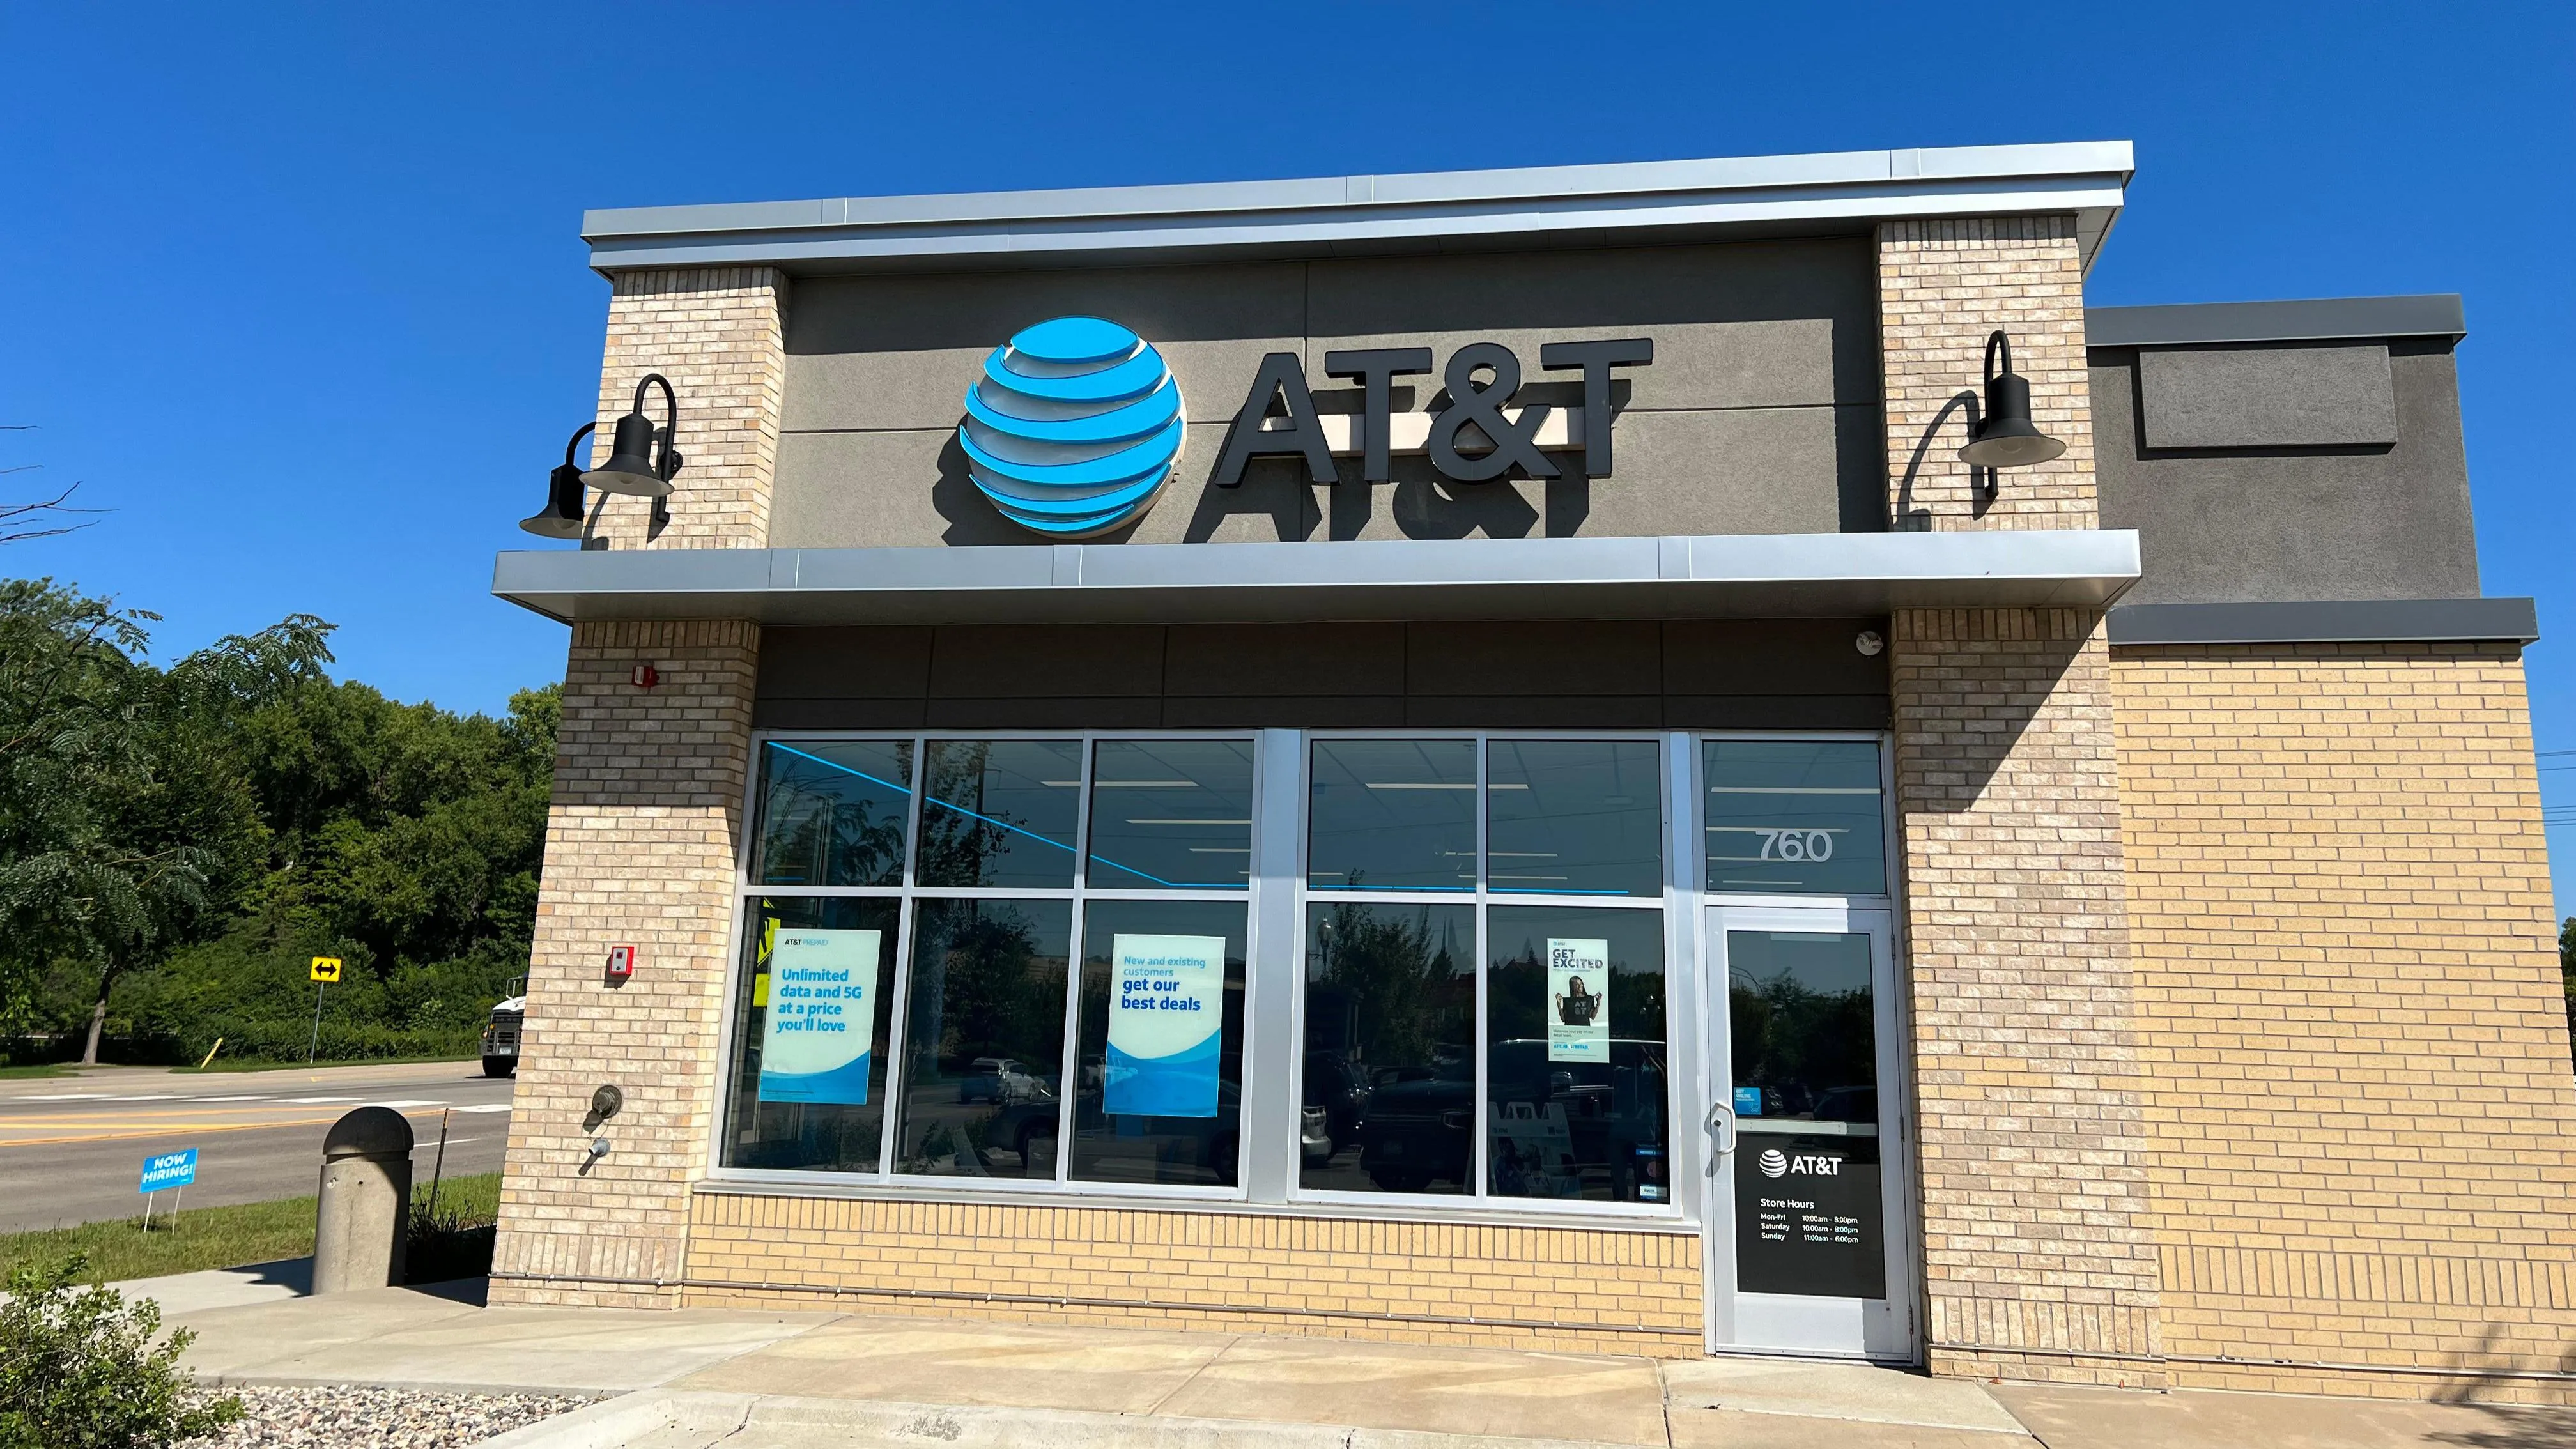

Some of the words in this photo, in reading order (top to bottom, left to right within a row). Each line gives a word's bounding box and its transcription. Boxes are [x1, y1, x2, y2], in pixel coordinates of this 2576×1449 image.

[1214, 338, 1653, 489] AT&T
[1755, 831, 1832, 862] 760
[1553, 949, 1575, 958] GET
[1124, 956, 1145, 965] New
[1148, 956, 1165, 965] and
[1168, 957, 1206, 969] existing
[1553, 958, 1603, 969] EXCITED
[782, 969, 849, 981] Unlimited
[1123, 968, 1173, 976] customers
[780, 985, 811, 997] data
[815, 986, 840, 998] and
[844, 987, 861, 999] 5G
[1123, 978, 1149, 994] get
[1153, 981, 1180, 991] our
[778, 1003, 792, 1014] at
[796, 1005, 803, 1014] a
[808, 1002, 842, 1017] price
[1122, 995, 1155, 1009] best
[1160, 997, 1201, 1011] deals
[776, 1018, 813, 1033] you'll
[817, 1019, 845, 1031] love
[153, 1153, 187, 1170] NOW
[1791, 1156, 1842, 1176] AT&T
[143, 1163, 193, 1183] HIRING!
[1761, 1198, 1785, 1208] Store
[1787, 1200, 1814, 1209] Hours
[1761, 1223, 1790, 1232] Saturday
[1761, 1232, 1785, 1241] Sunday
